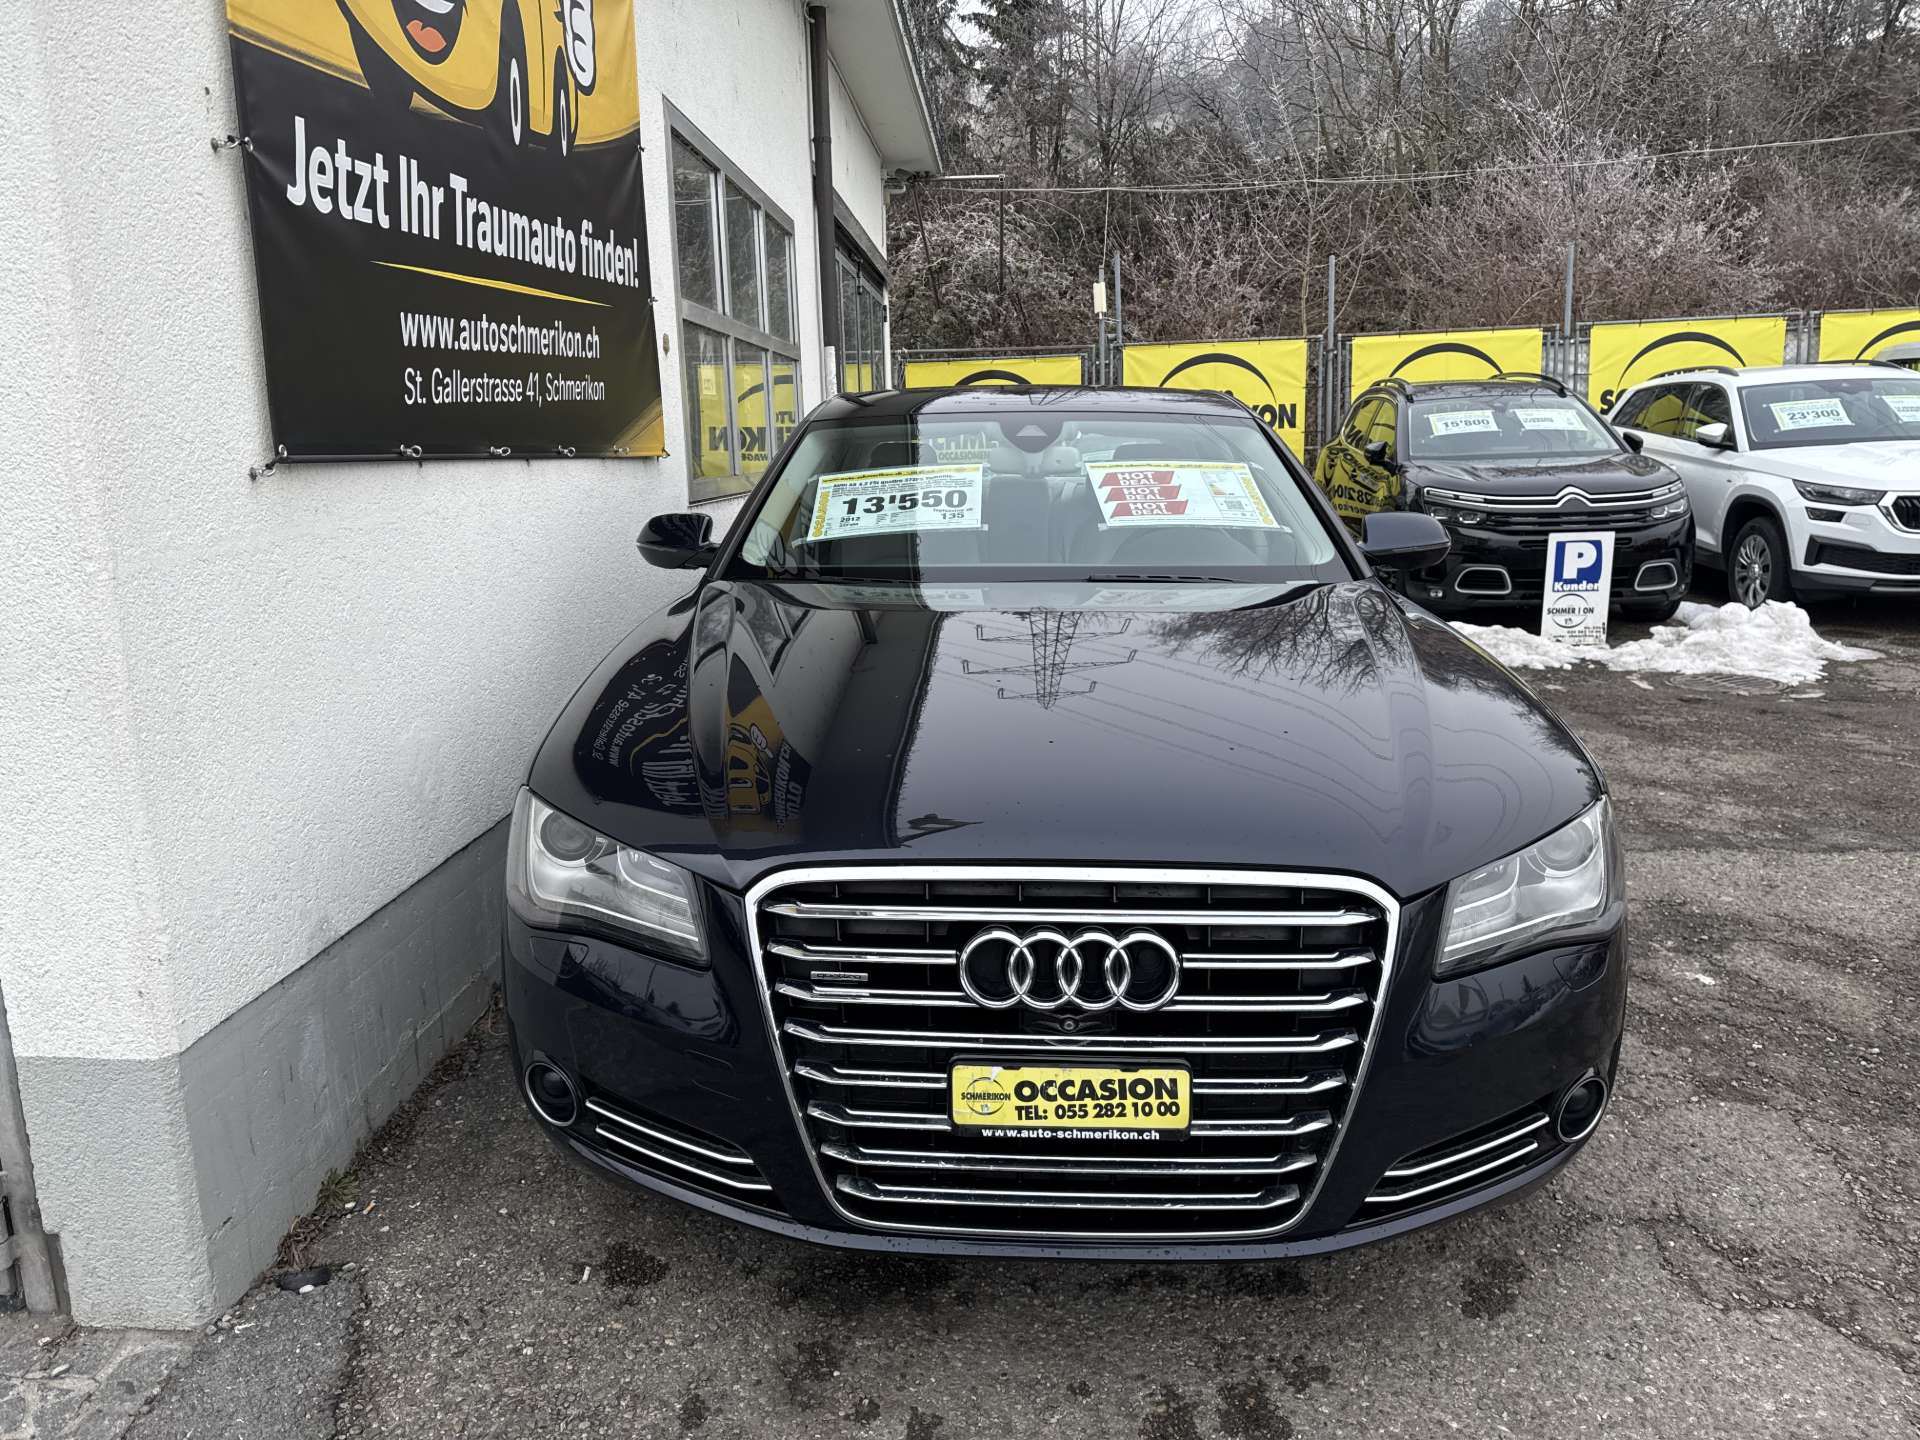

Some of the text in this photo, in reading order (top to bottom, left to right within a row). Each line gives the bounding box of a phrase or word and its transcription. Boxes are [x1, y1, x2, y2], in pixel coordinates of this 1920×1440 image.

[286, 115, 639, 288] Jetzt Ihr Traumauto finden!
[400, 311, 600, 359] www.autoschmerikon.ch
[404, 367, 605, 408] St. Gallerstrasse 41, Schmerikon
[1786, 409, 1841, 421] 23'300
[1442, 418, 1491, 430] 15'800
[1116, 472, 1155, 480] HOT
[1122, 486, 1161, 495] HOT
[842, 490, 968, 516] 13'550
[1128, 502, 1168, 510] HOT
[1562, 541, 1598, 580] P
[961, 1091, 1011, 1101] SCHMERIKON
[1014, 1078, 1178, 1101] OCCASION
[1015, 1101, 1180, 1121] TEL: 055 282 10 00
[981, 1127, 1160, 1140] www.auto-schmerikon.ch
